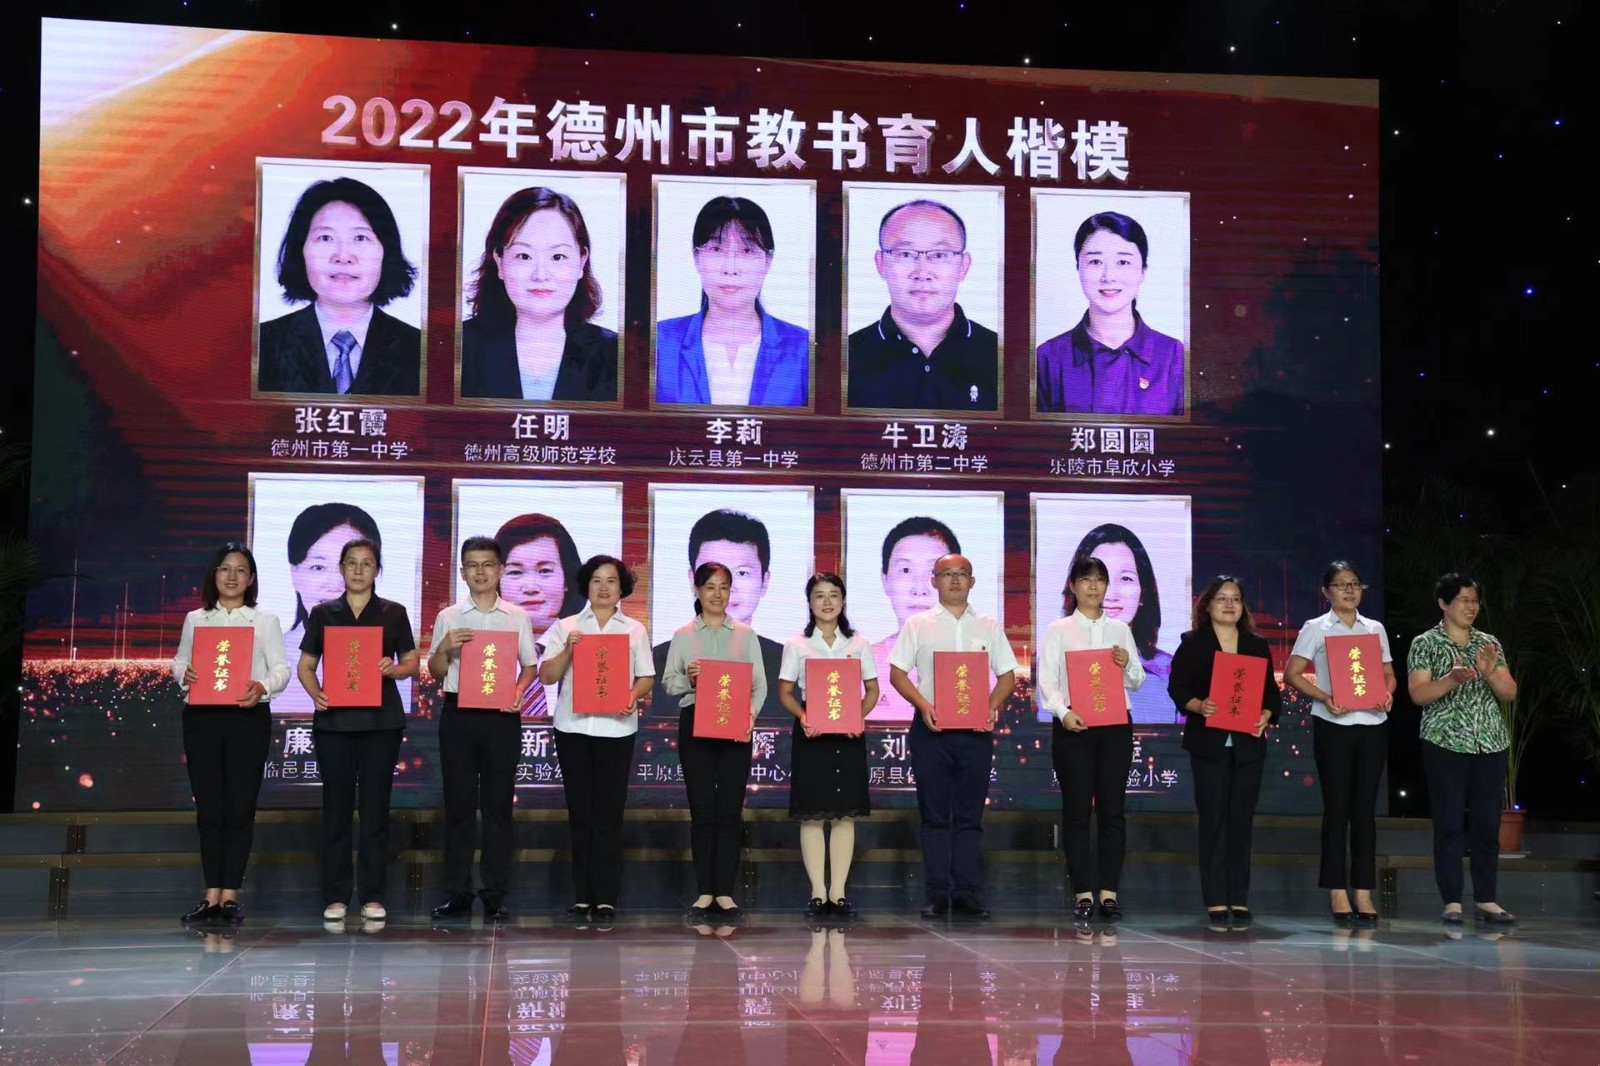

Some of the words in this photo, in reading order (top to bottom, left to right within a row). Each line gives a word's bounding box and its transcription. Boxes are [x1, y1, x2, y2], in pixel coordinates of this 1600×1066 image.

[320, 94, 1130, 184] 2022年德州市教书育人楷模
[294, 407, 388, 437] 张红霞
[511, 413, 571, 441] 任明
[705, 418, 763, 446] 李莉
[881, 422, 969, 451] 牛卫涛
[270, 439, 409, 461] 德州市第一中学
[464, 443, 617, 466] 德州高级师范学校
[1070, 427, 1156, 456] 郑圆圆
[668, 447, 799, 470] 庆云县第一中学
[860, 452, 989, 474] 德州市第二中学
[1049, 458, 1177, 478] 乐陵市阜欣小学
[213, 639, 231, 692] 荣誉证书
[345, 640, 362, 692] 荣誉证书
[479, 643, 497, 696] 荣誉证书
[594, 647, 610, 700] 荣誉证书
[1348, 647, 1367, 697] 荣誉证书
[716, 674, 734, 726] 荣誉证书
[826, 671, 842, 721] 荣誉证书
[955, 664, 971, 717] 荣誉证书
[1088, 661, 1107, 713] 荣誉证书
[1228, 667, 1246, 717] 荣誉证书
[283, 727, 313, 755] 廉
[521, 730, 557, 758] 新
[881, 734, 906, 761] 刘
[751, 764, 791, 782] 中心
